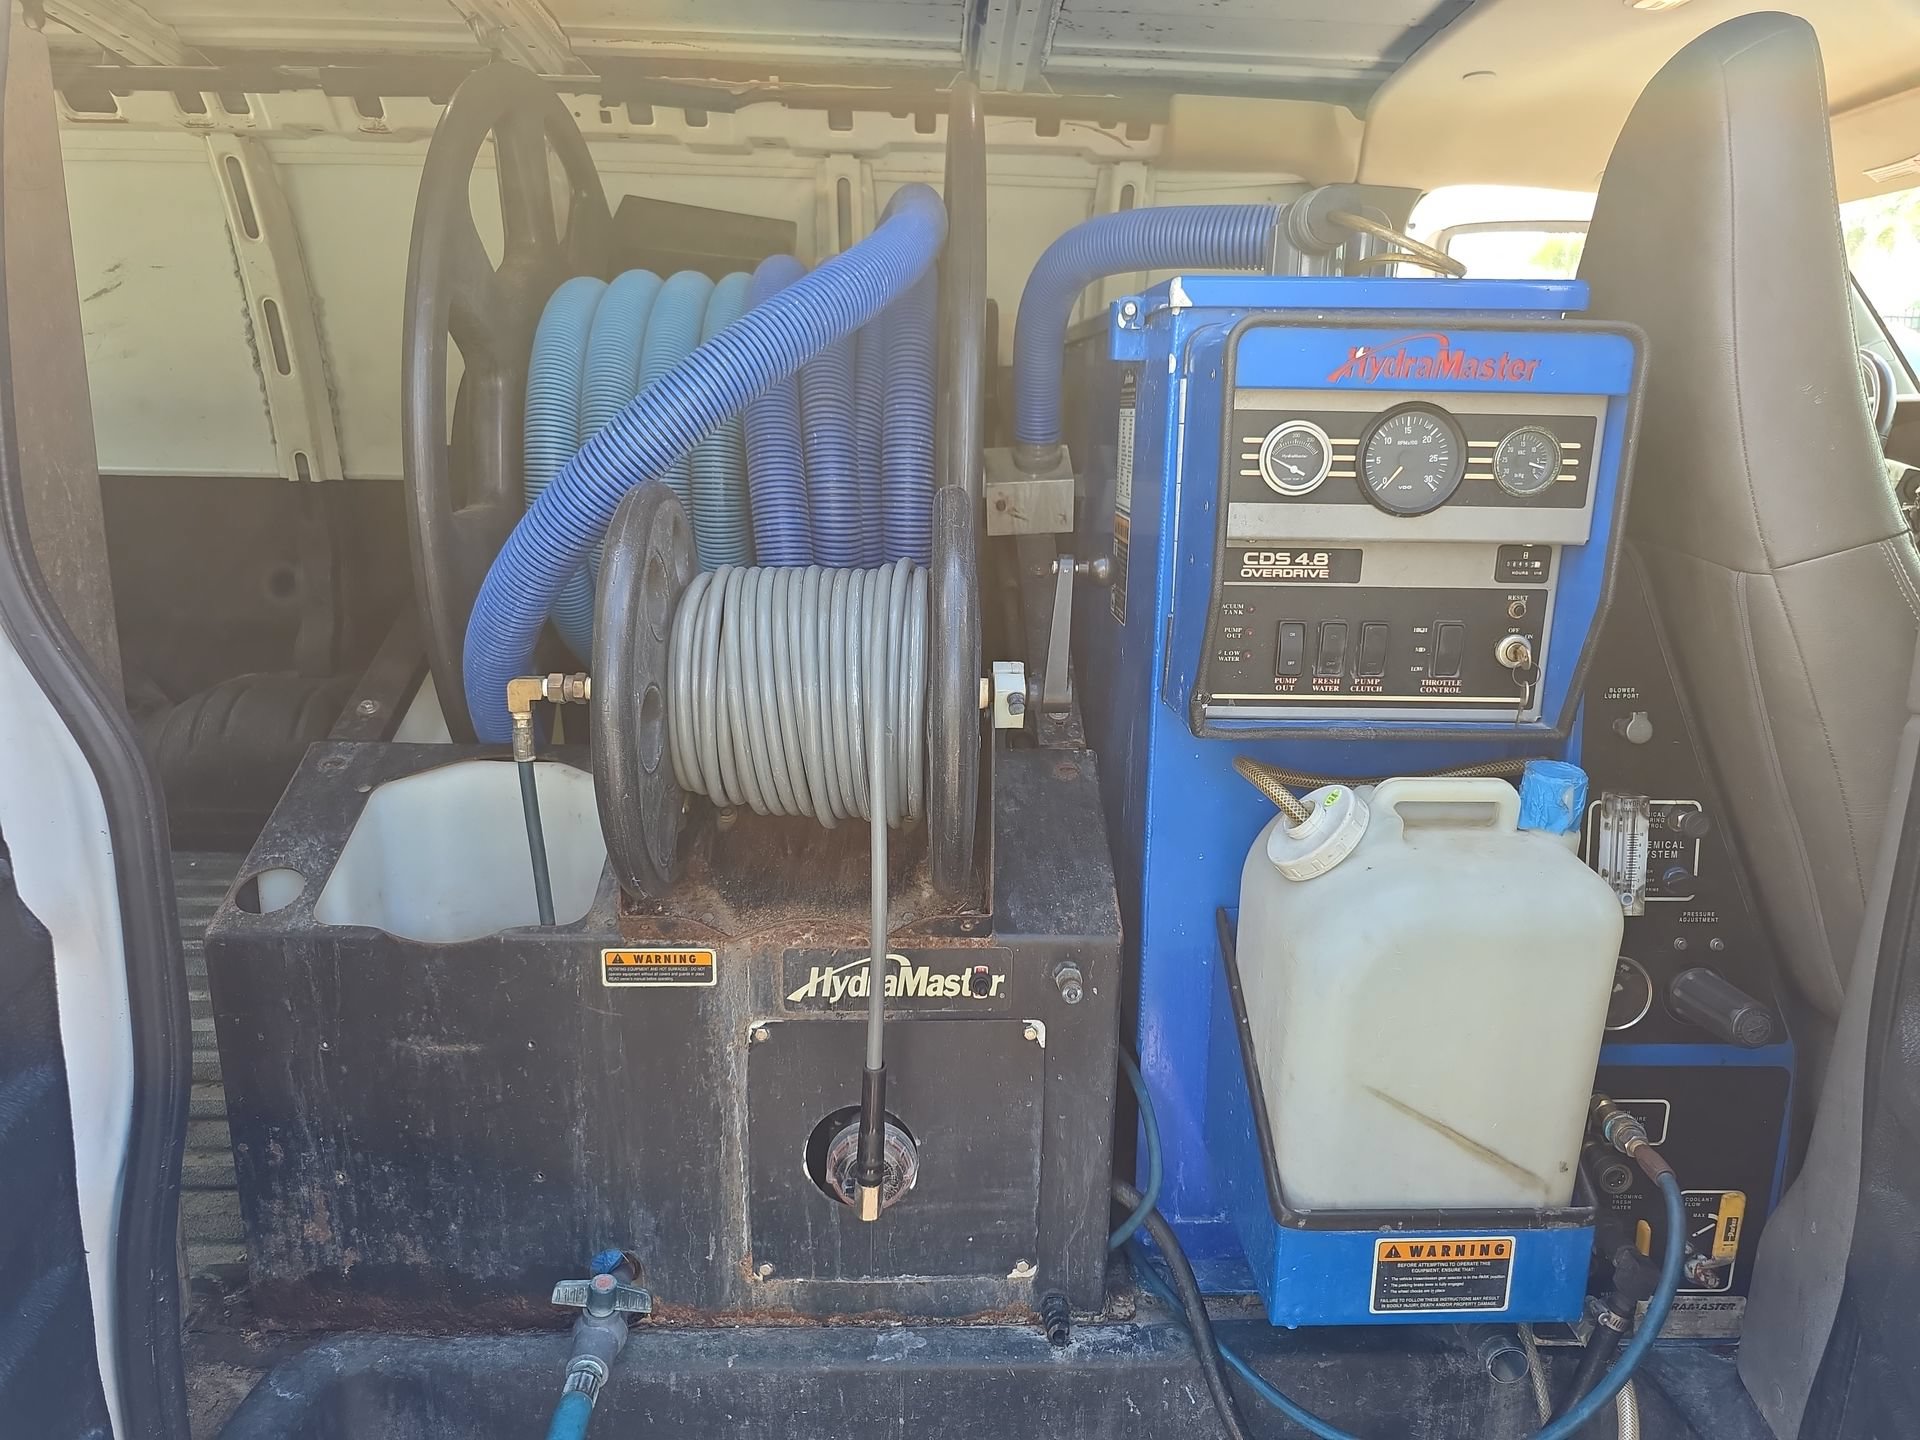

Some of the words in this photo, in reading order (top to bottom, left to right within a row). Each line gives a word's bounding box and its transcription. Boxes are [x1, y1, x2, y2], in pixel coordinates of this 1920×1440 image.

[1330, 336, 1541, 384] HydraMaster
[1429, 454, 1438, 462] 25
[1243, 552, 1291, 565] CDS
[1295, 552, 1329, 566] 4.8
[1240, 568, 1329, 578] OVERDRIVE
[1648, 841, 1684, 849] EMICAL
[1647, 850, 1678, 858] STEM
[633, 954, 697, 964] WARNING
[787, 956, 1005, 1003] HydaMastr
[1410, 1244, 1505, 1258] WARNING
[1671, 1303, 1736, 1311] RAMASTER
